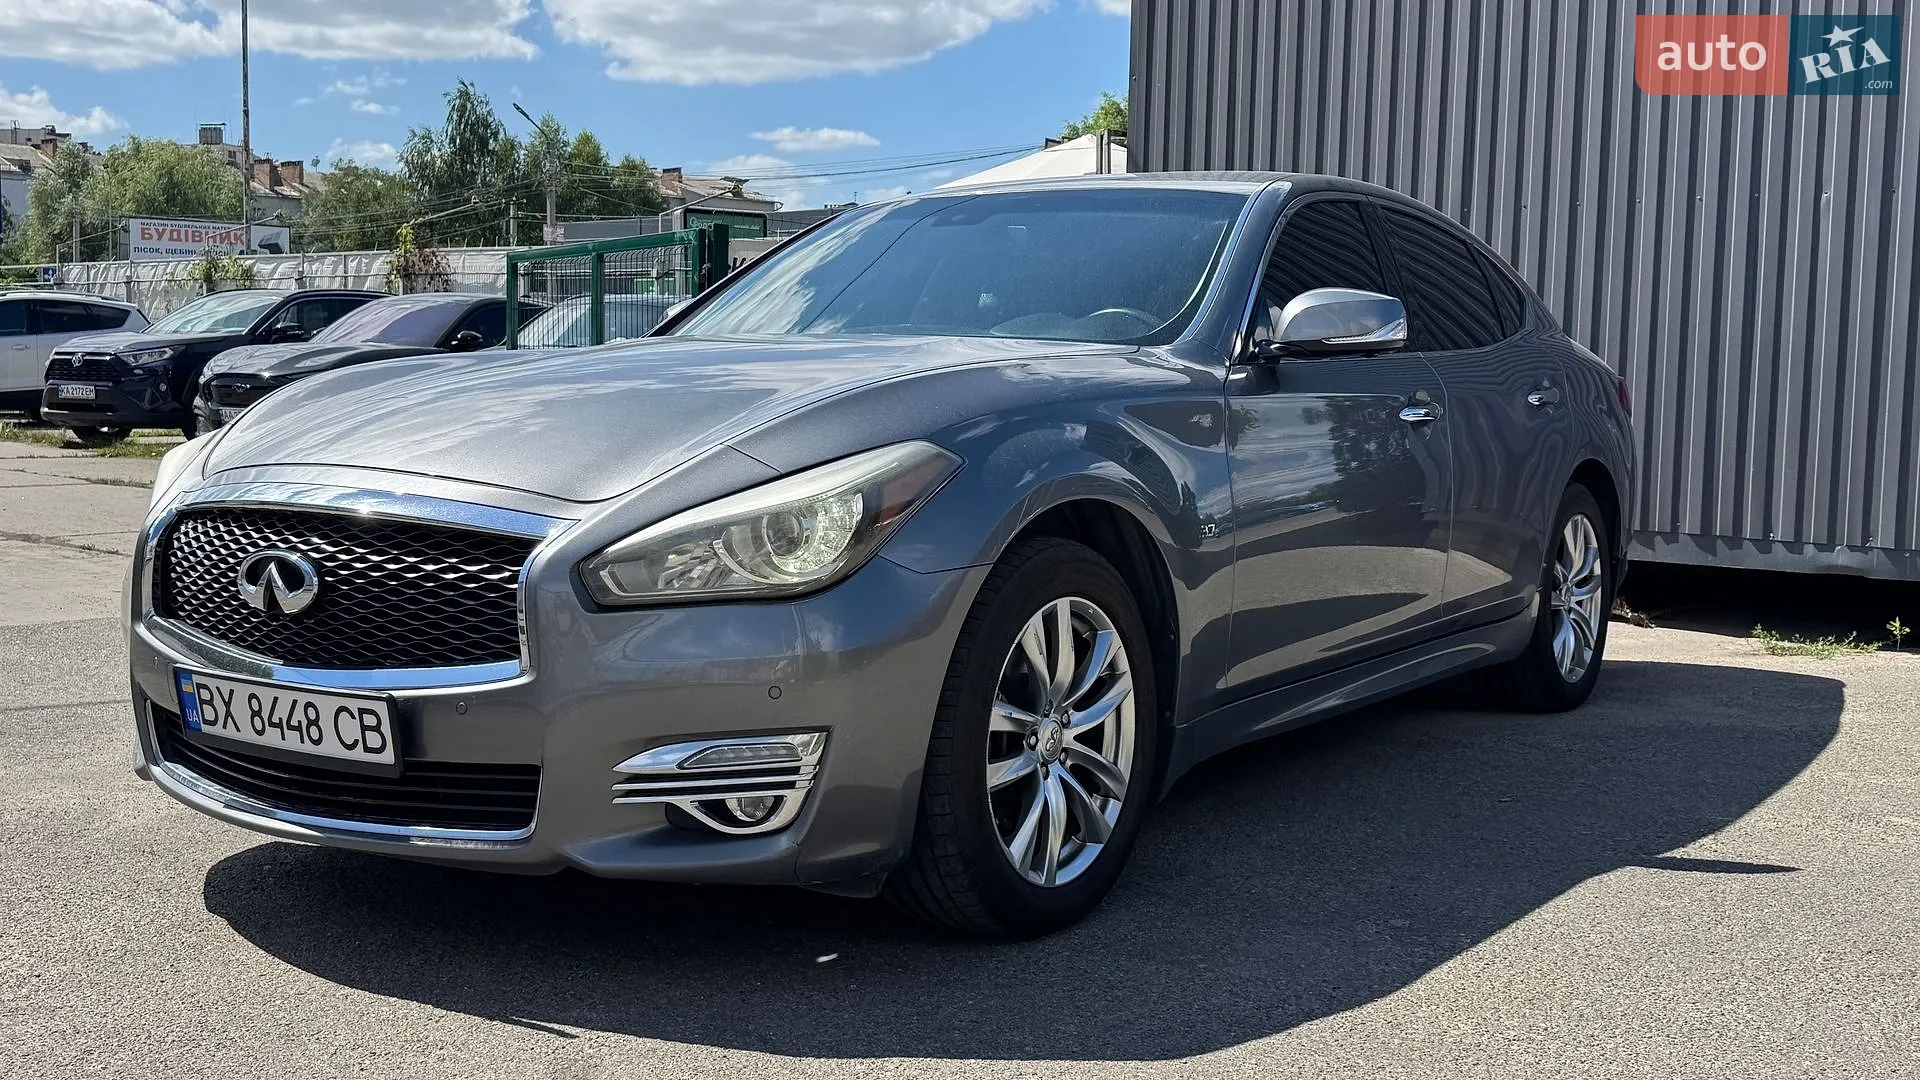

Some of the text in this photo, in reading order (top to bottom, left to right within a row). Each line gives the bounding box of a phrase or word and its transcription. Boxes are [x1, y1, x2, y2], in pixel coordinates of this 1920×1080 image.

[140, 227, 246, 245] БУДІВНИК
[186, 708, 200, 723] UA
[195, 682, 387, 754] BX 8448 CB
